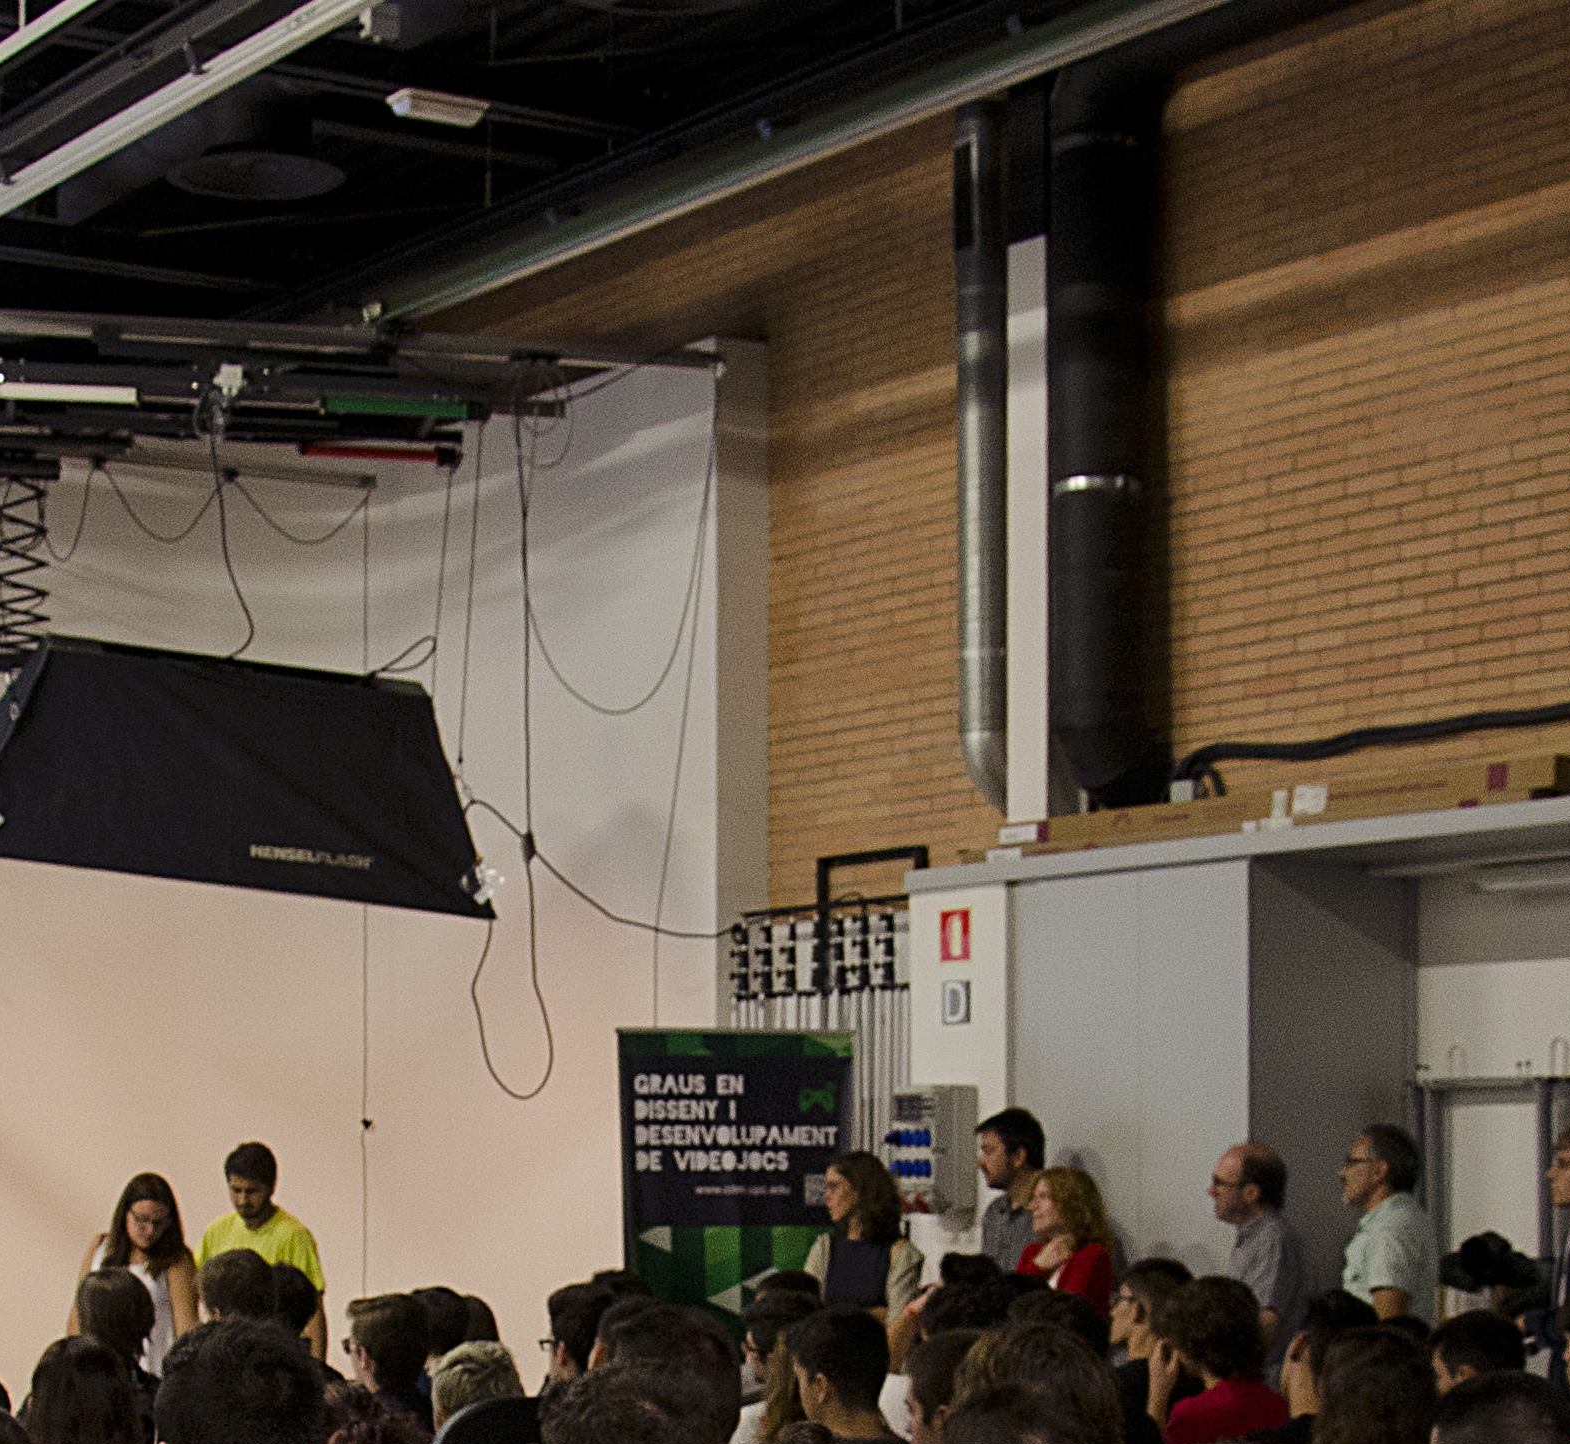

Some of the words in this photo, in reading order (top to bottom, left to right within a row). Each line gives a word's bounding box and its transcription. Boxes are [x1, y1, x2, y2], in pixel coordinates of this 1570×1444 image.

[634, 1074, 706, 1095] GRAUS
[716, 1074, 744, 1095] EN
[634, 1100, 719, 1121] DISSENY
[729, 1100, 737, 1121] I
[635, 1125, 838, 1147] DESENVOLUPAMENT
[635, 1150, 663, 1172] DE
[674, 1151, 789, 1172] VIDEOJOCS
